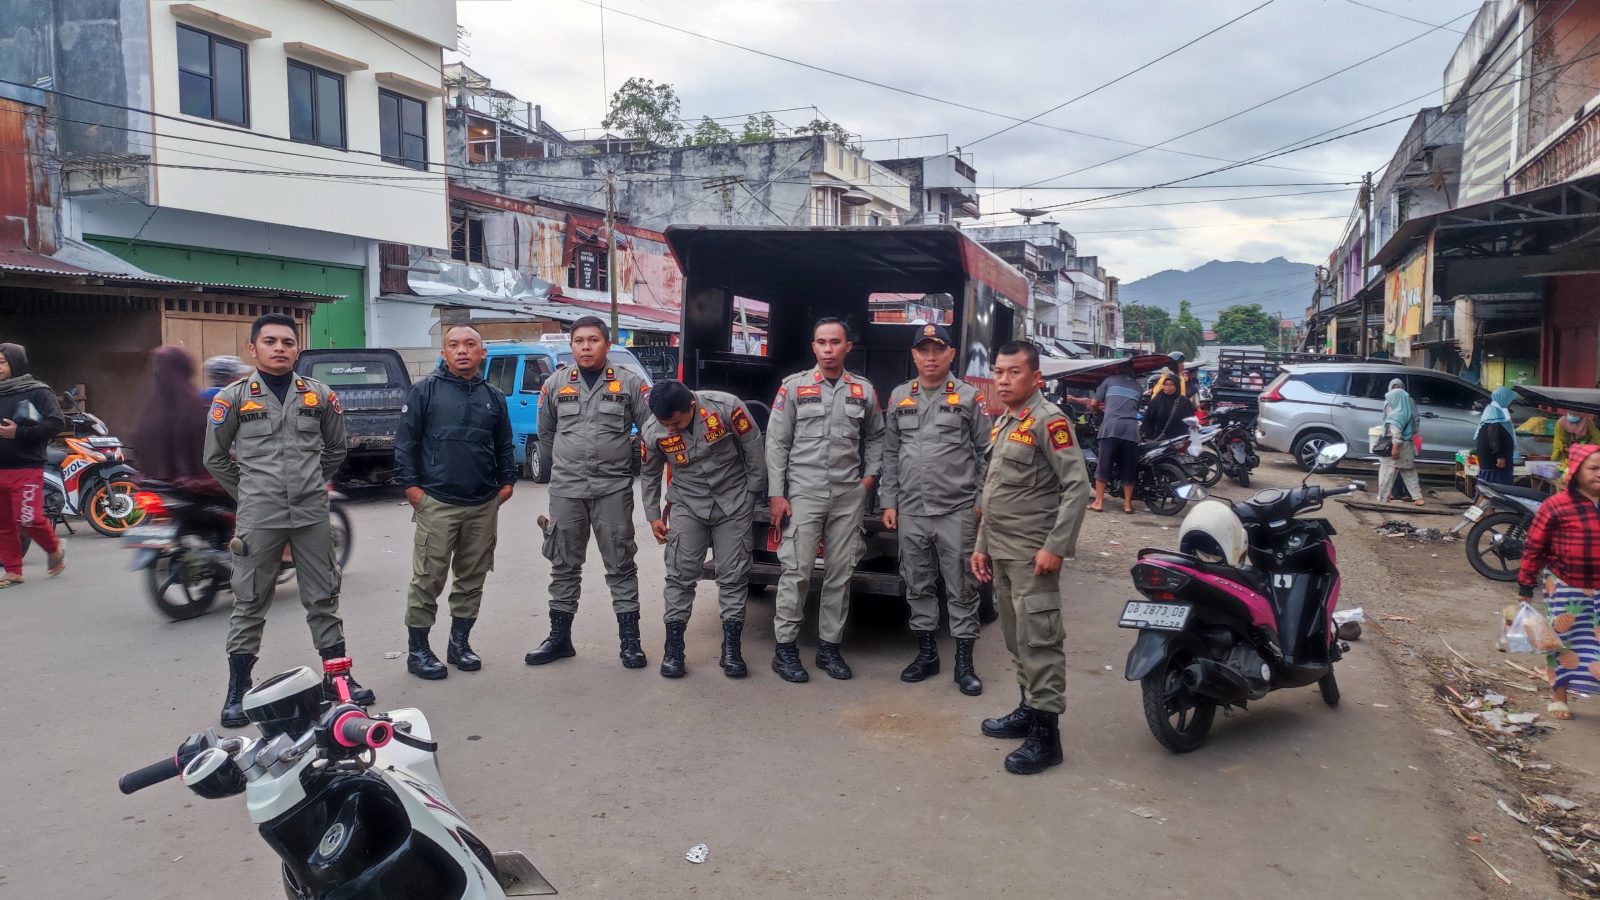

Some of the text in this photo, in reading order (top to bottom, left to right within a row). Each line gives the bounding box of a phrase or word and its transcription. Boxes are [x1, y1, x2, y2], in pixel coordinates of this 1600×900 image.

[705, 427, 727, 440] POLISI
[1009, 431, 1033, 444] POLISI
[1127, 602, 1187, 618] DB 2873 DB
